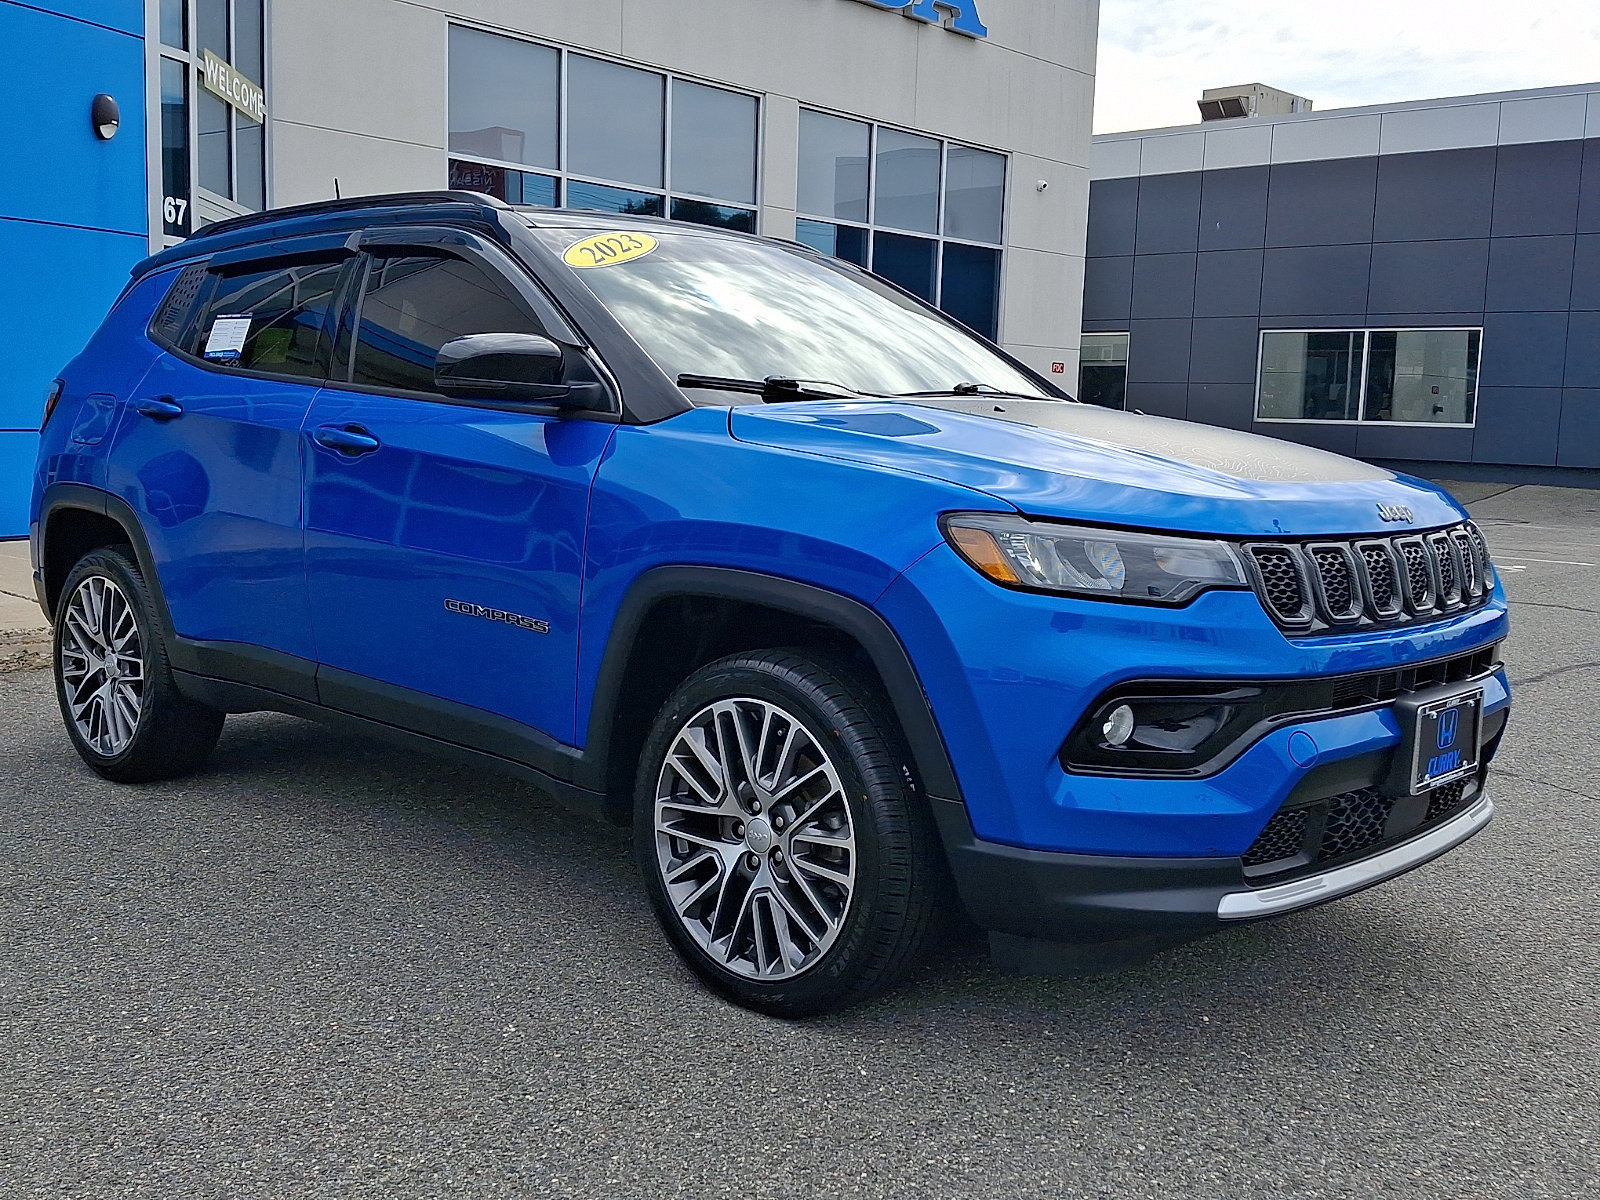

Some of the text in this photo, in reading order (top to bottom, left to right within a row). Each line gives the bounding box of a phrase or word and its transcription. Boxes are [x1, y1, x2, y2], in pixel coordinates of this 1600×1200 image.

[204, 55, 263, 118] WELCOME
[164, 196, 187, 225] 67
[579, 234, 643, 264] 2023
[1376, 502, 1413, 524] Jeep
[443, 598, 550, 634] COMPASS
[1427, 748, 1461, 776] CURRY
